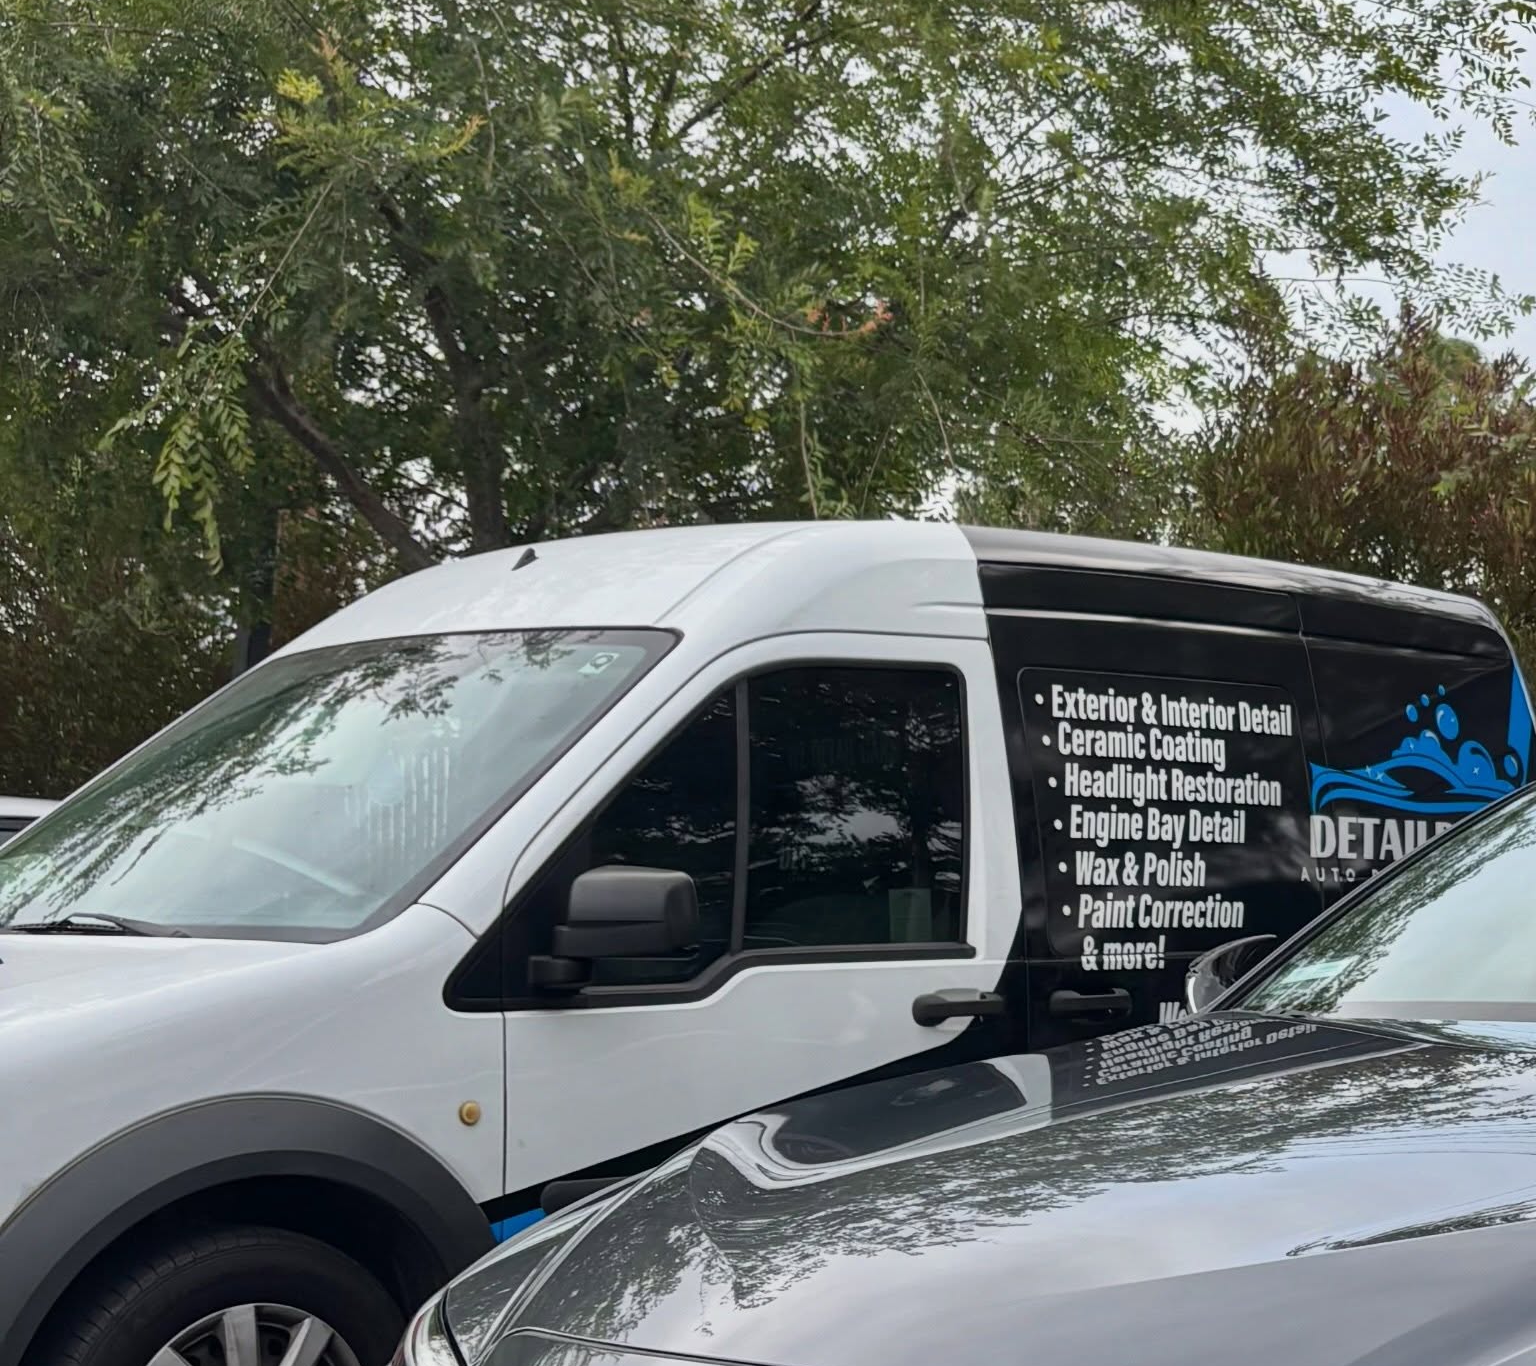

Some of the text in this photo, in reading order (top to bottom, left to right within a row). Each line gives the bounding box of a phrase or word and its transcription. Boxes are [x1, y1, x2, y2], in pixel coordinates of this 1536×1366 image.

[1051, 684, 1293, 736] Exterior & Interior Detail
[1058, 721, 1226, 772] Ceramic Coating
[1064, 762, 1282, 808] Headlight Restoration
[1069, 804, 1246, 849] Engine Bay Detail
[1075, 850, 1206, 887] Wax & Polish
[1300, 866, 1357, 883] AUTO
[1077, 892, 1245, 929] Paint Correction
[1080, 934, 1166, 971] & more!
